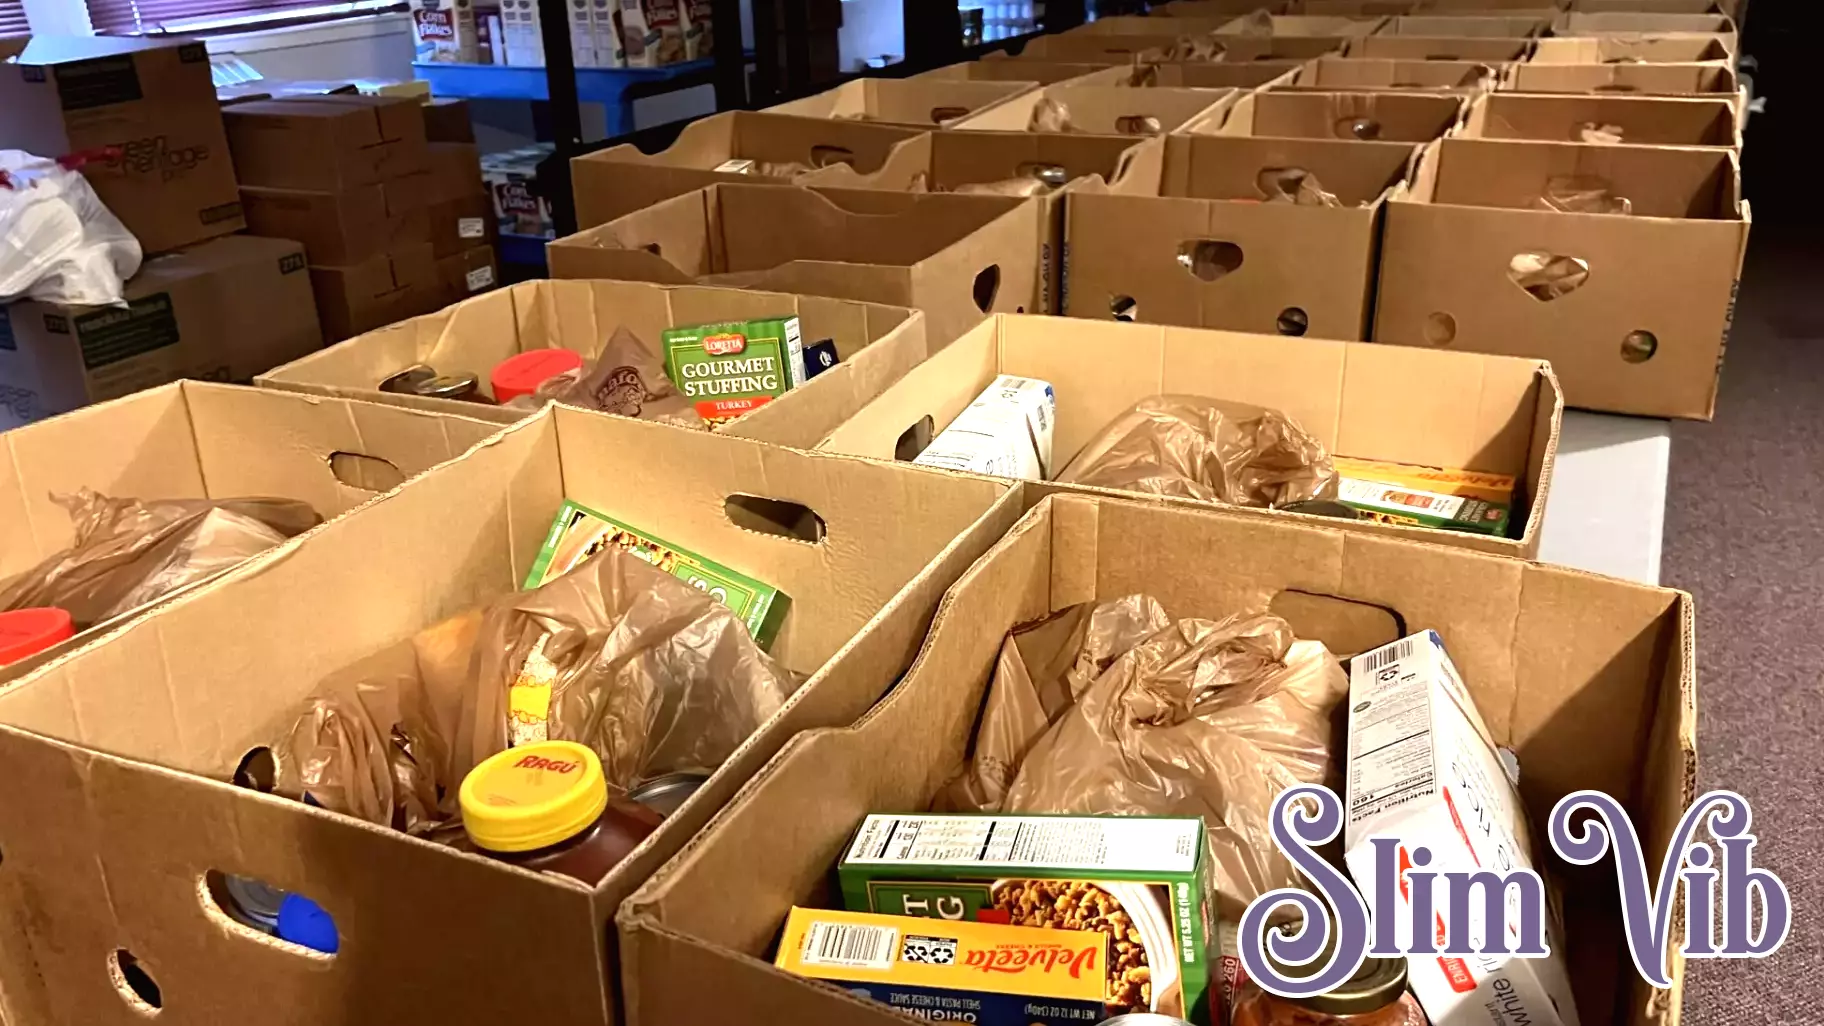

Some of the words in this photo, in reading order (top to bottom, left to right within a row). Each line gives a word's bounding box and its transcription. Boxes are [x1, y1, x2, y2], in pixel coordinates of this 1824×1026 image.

[419, 10, 448, 24] Corn
[704, 336, 743, 351] LORETTA
[682, 356, 775, 379] GOURMET
[684, 374, 778, 397] STUFFING
[715, 399, 752, 411] TURKEY
[963, 943, 1098, 980] Velveeta
[1223, 958, 1236, 983] 260
[890, 994, 911, 1005] SAUCE
[911, 995, 934, 1007] CHEESE
[935, 996, 941, 1006] &
[942, 997, 961, 1009] PASTA
[962, 999, 981, 1010] SHELL
[1489, 978, 1533, 1026] white
[1024, 1003, 1049, 1017] (340g)
[1050, 1006, 1060, 1017] OZ
[1060, 1007, 1069, 1018] 12
[1069, 1008, 1081, 1019] WT
[1082, 1009, 1096, 1020] NET
